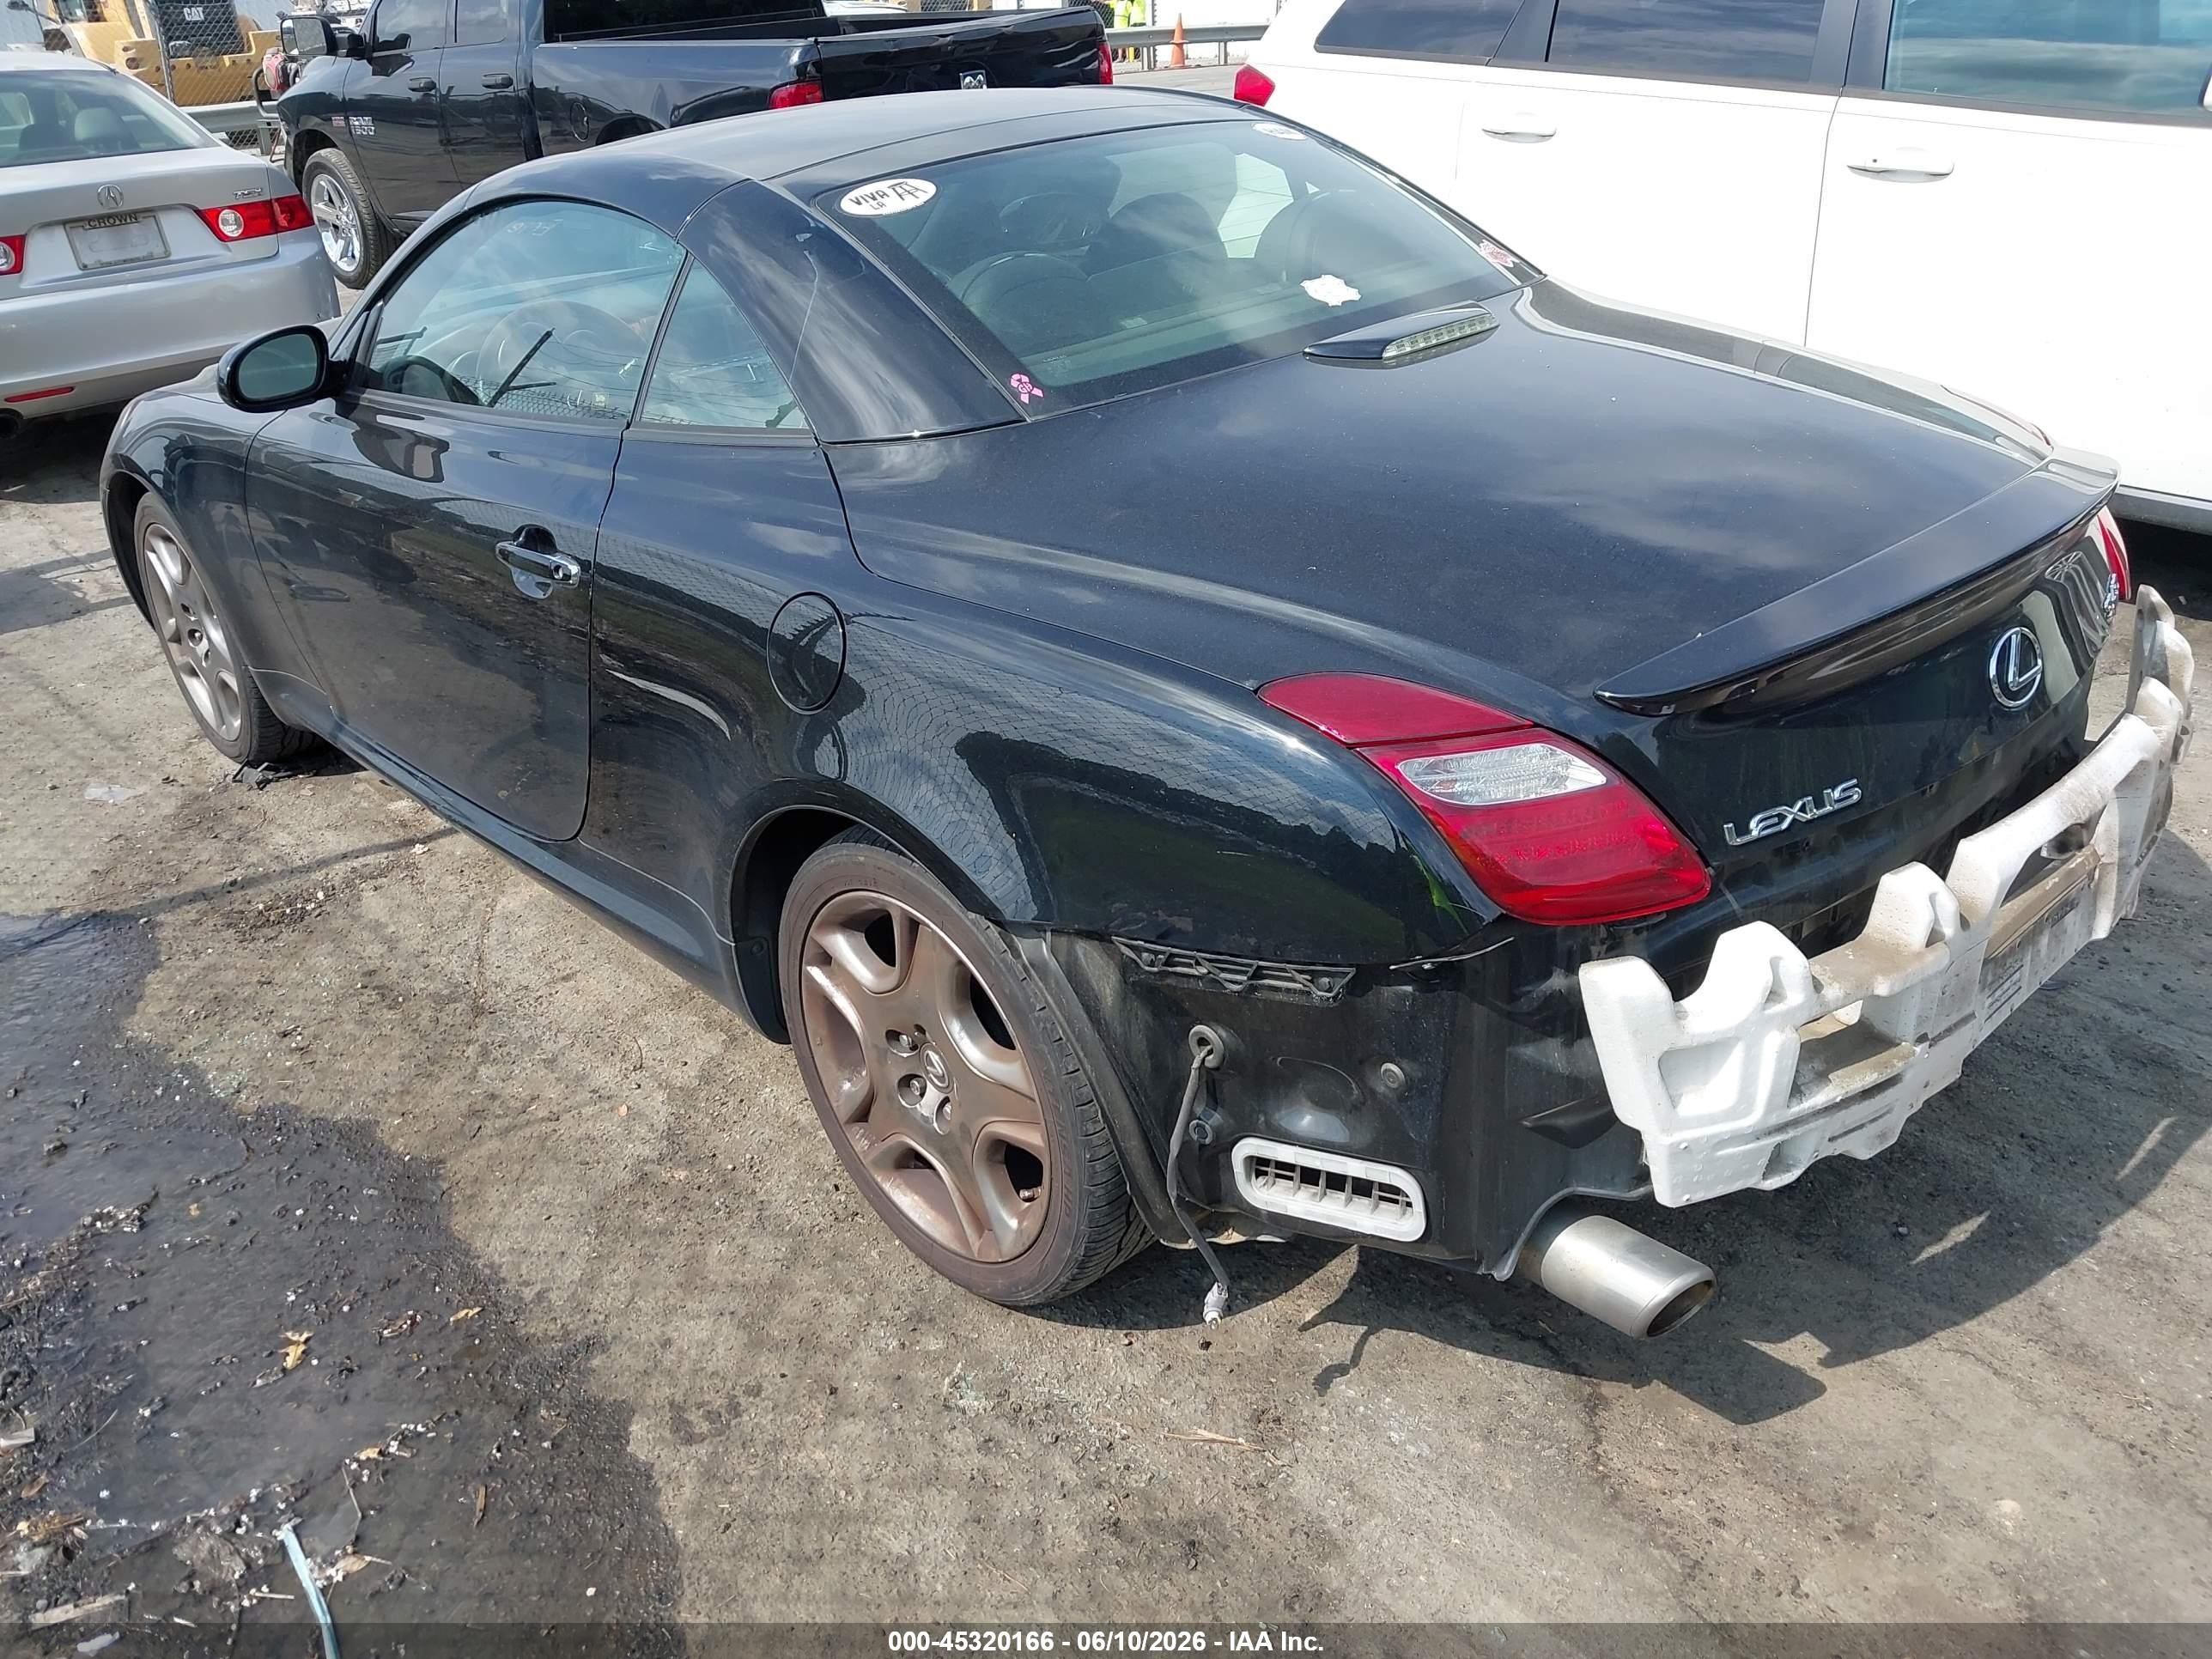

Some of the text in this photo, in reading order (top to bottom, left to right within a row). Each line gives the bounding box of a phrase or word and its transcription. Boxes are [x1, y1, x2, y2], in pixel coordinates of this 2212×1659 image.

[183, 7, 204, 21] CAT
[848, 189, 890, 206] VIVA
[870, 201, 886, 210] LA
[88, 213, 138, 228] CROWN
[1723, 778, 1862, 846] LEXUS
